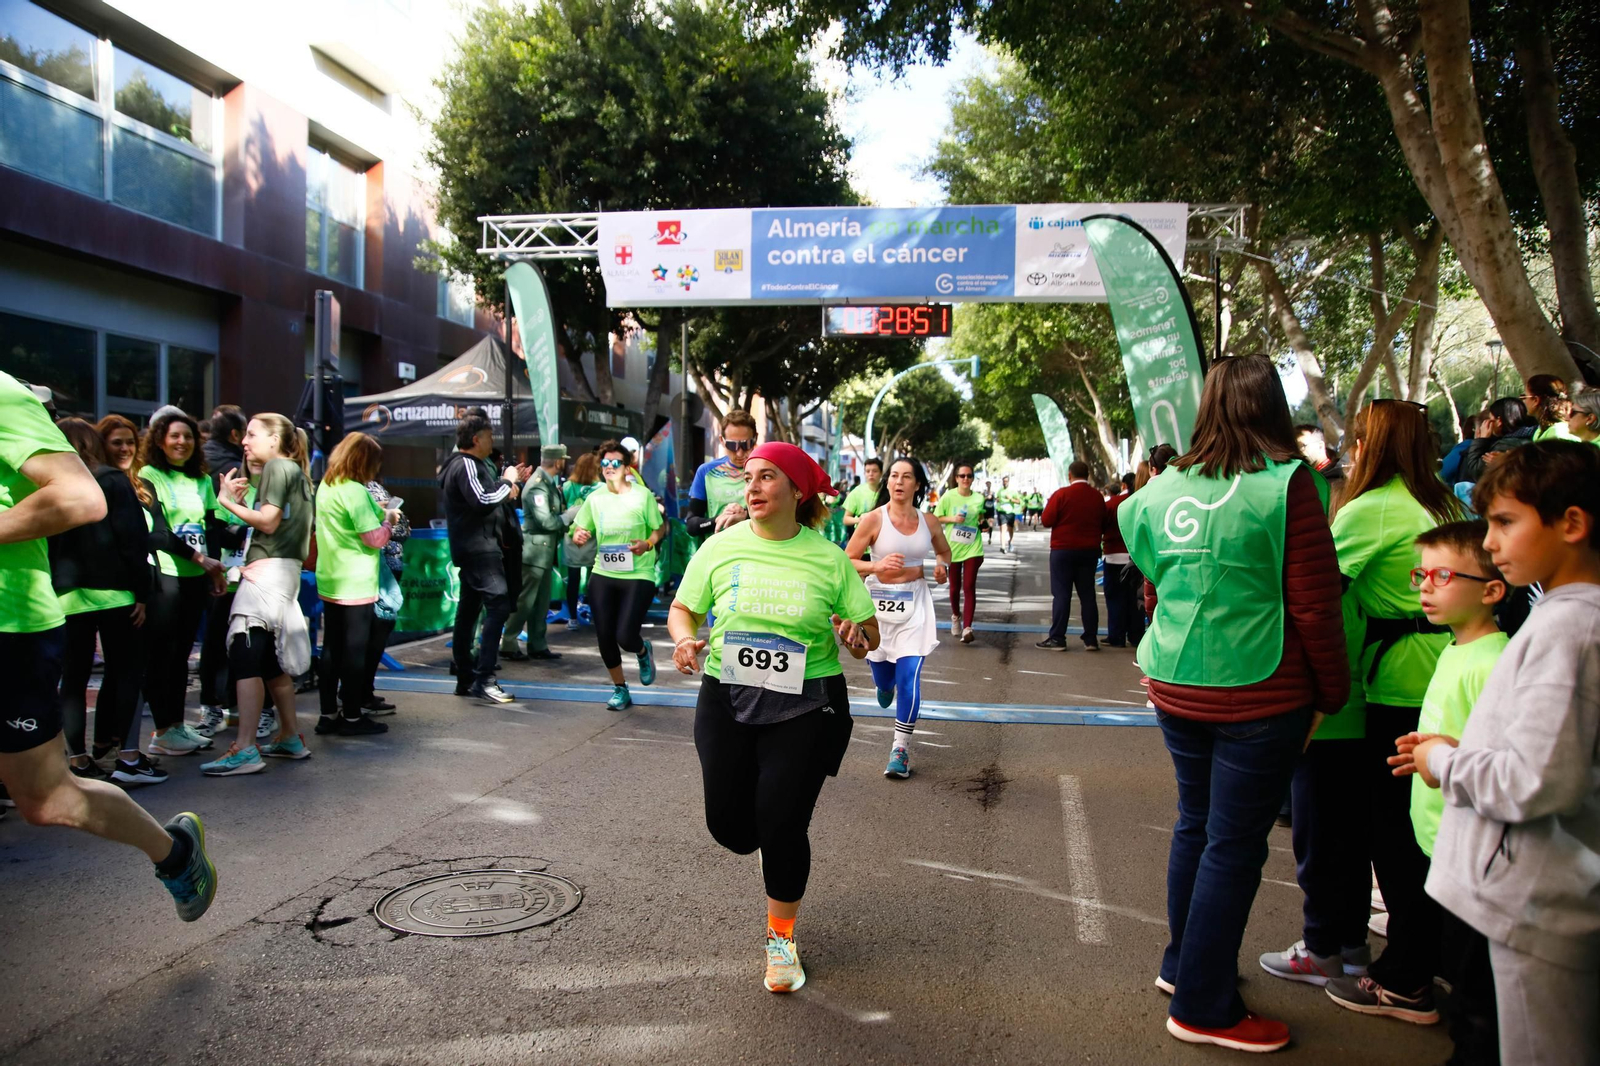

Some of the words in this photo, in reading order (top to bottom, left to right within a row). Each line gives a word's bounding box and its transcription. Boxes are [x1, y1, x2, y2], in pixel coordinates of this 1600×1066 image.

[767, 216, 861, 238] Almería
[870, 221, 899, 236] en
[907, 215, 1000, 236] marcha
[1048, 217, 1083, 230] cajam
[768, 245, 846, 266] contra
[853, 244, 875, 264] el
[882, 244, 968, 264] cáncer
[761, 283, 839, 291] #TodosContraElCáncer
[955, 530, 972, 539] 842
[603, 552, 626, 563] 666
[728, 563, 741, 612] ALMERÍA
[741, 575, 757, 585] En
[761, 577, 807, 589] marcha
[741, 587, 788, 599] contra
[793, 590, 806, 602] el
[740, 598, 806, 617] cáncer
[878, 600, 905, 613] 524
[738, 647, 789, 672] 693
